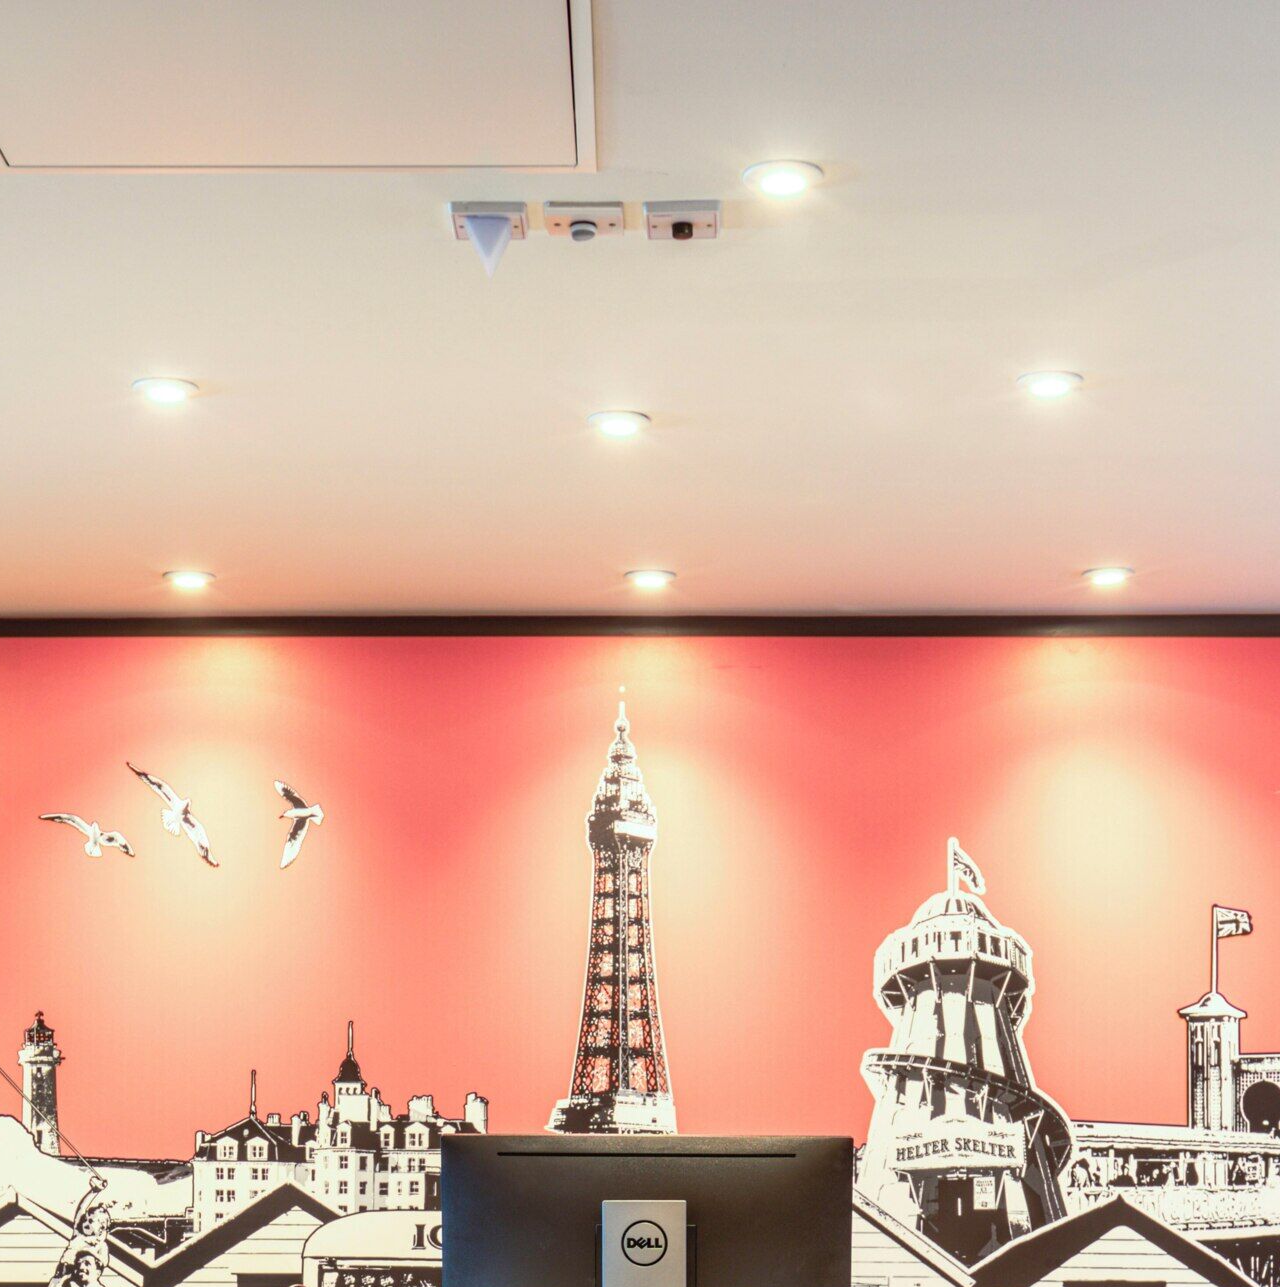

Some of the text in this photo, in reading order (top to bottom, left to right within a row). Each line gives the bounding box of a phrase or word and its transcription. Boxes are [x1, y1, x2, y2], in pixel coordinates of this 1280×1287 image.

[896, 1137, 1017, 1162] HELTER SKELTER
[626, 1237, 663, 1249] DELL
